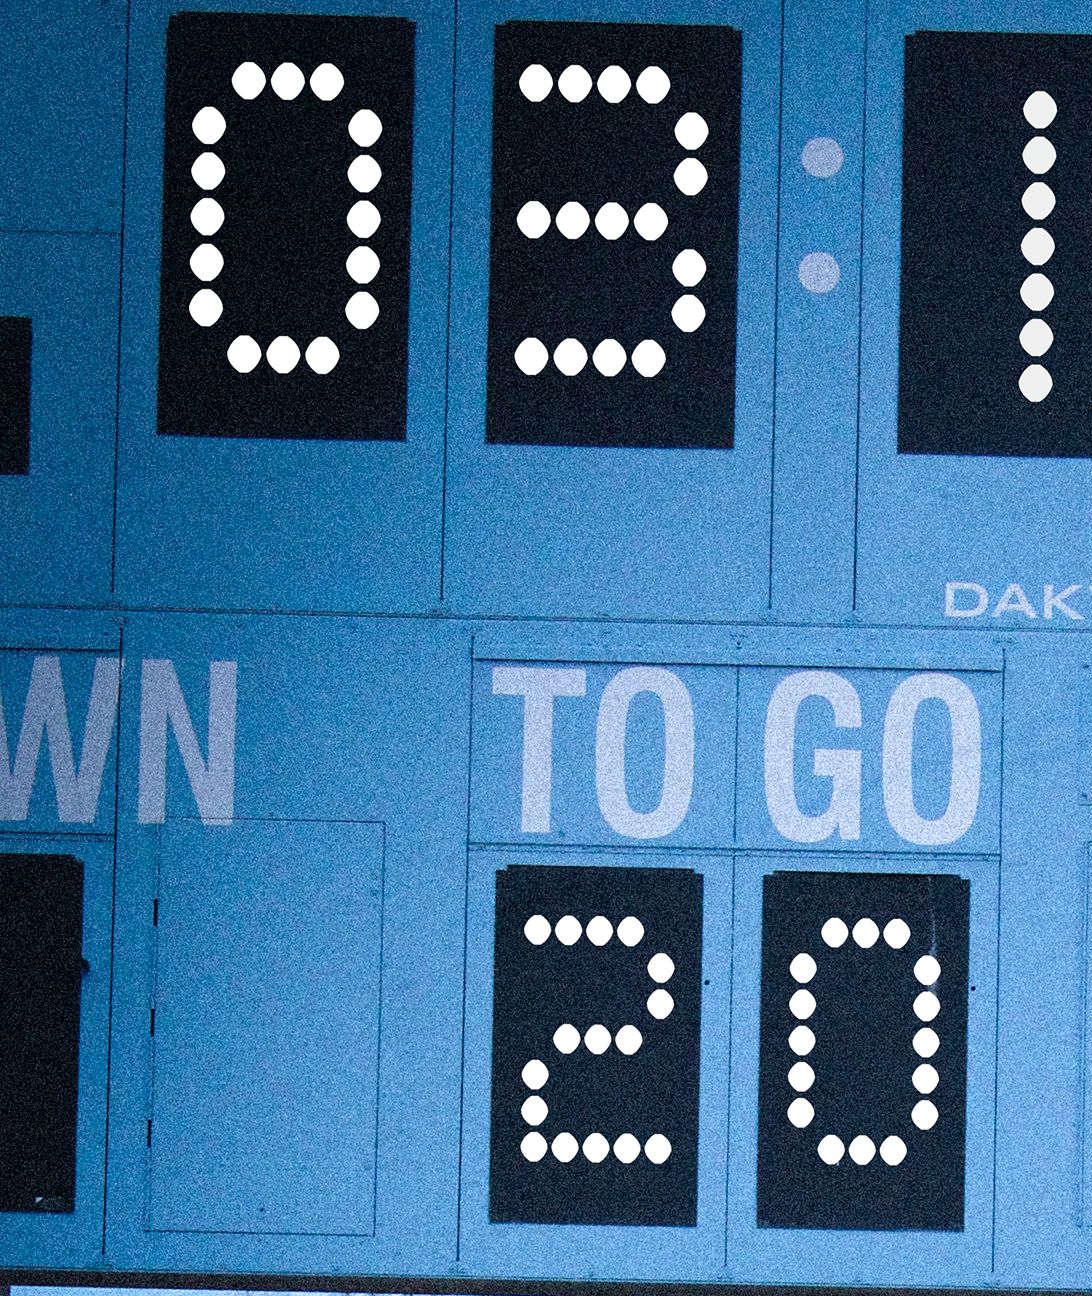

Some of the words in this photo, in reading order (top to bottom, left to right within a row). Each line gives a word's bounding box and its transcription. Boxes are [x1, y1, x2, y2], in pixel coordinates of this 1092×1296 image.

[491, 666, 695, 839] TO
[763, 671, 981, 844] GO
[521, 914, 943, 1166] 20
